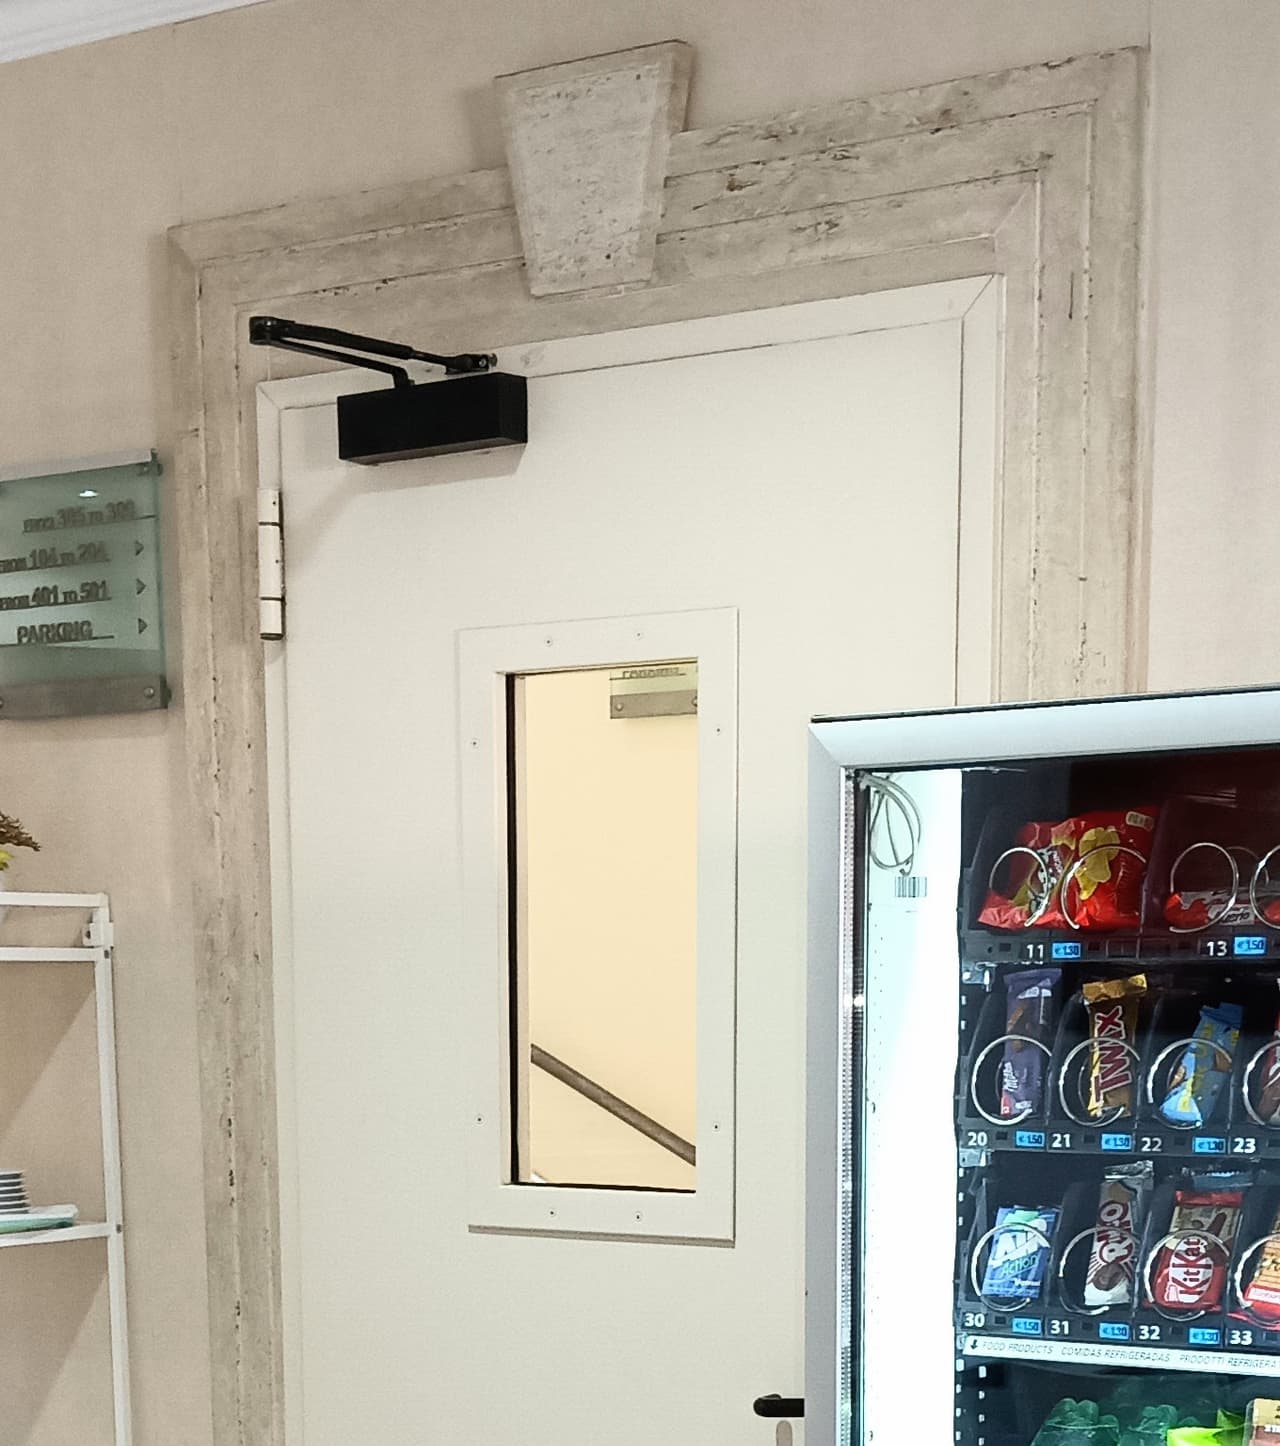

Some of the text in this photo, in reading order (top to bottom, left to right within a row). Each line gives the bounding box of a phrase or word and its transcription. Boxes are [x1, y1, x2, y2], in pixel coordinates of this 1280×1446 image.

[32, 585, 59, 606] 401
[80, 580, 107, 601] 501
[16, 621, 94, 645] PARKING
[1026, 944, 1044, 959] 11
[1206, 941, 1228, 956] 13
[1094, 1005, 1132, 1103] TWIX
[967, 1132, 988, 1146] 20
[1052, 1133, 1071, 1148] 21
[1141, 1137, 1162, 1152] 22
[1233, 1137, 1256, 1153] 23
[964, 1312, 985, 1328] 30
[1050, 1320, 1070, 1335] 31
[1138, 1325, 1161, 1340] 32
[1229, 1330, 1252, 1345] 33
[1008, 1342, 1054, 1355] PRODUCTS
[1061, 1346, 1171, 1363] COMIDAS REFRIGERADAS
